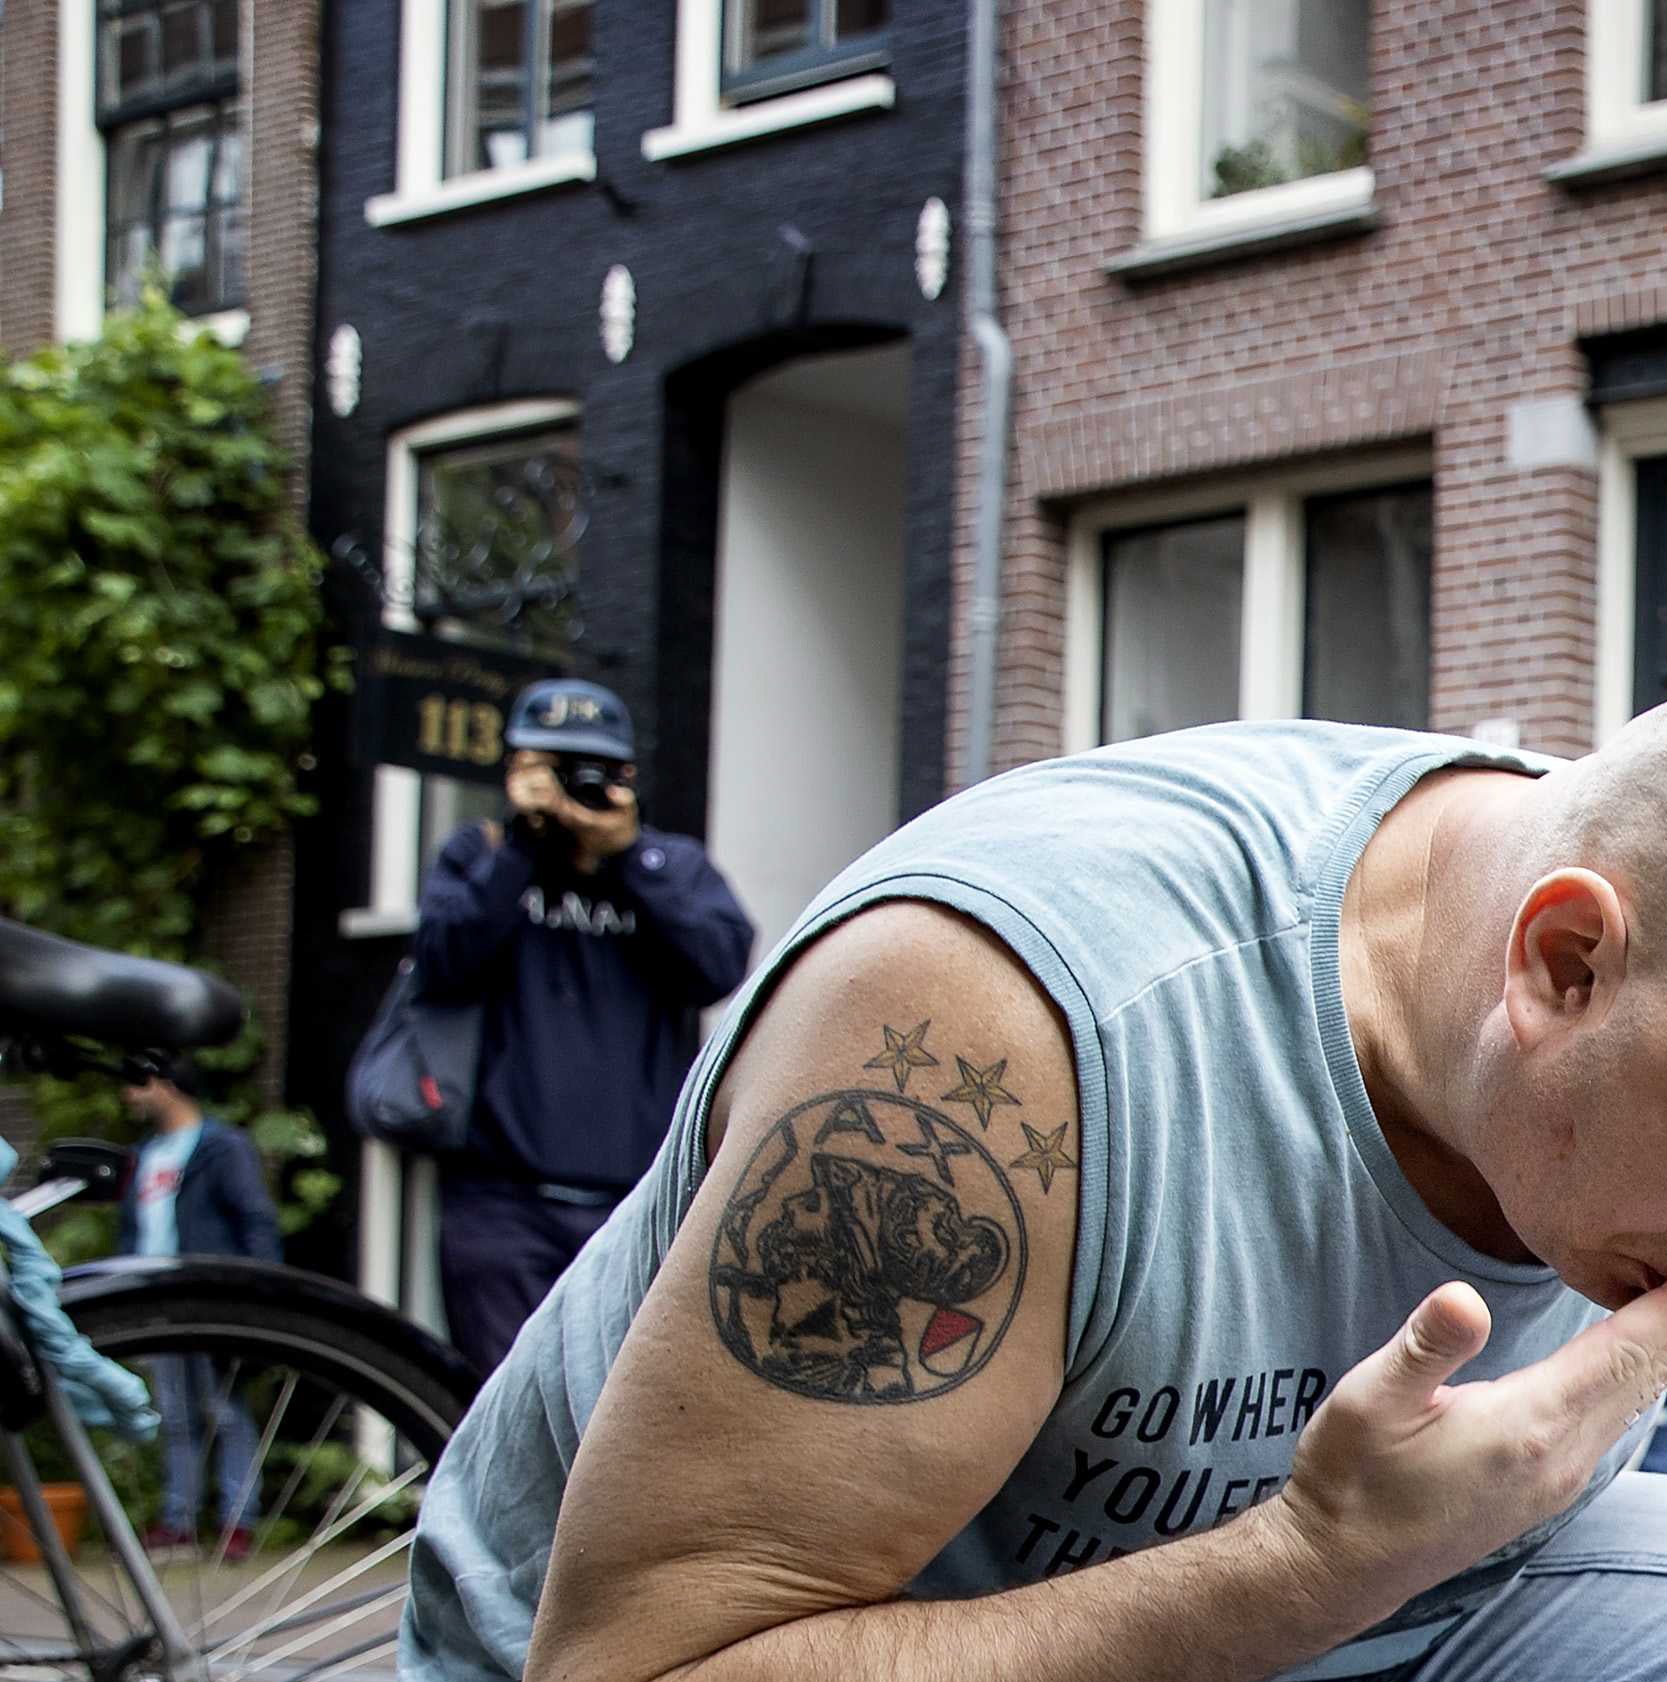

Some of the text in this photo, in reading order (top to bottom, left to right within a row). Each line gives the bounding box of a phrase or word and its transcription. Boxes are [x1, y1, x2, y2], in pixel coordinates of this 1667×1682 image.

[420, 693, 503, 766] 113
[1090, 1385, 1181, 1444] GO
[1062, 1447, 1213, 1537] YOU
[1015, 1512, 1136, 1578] TH
